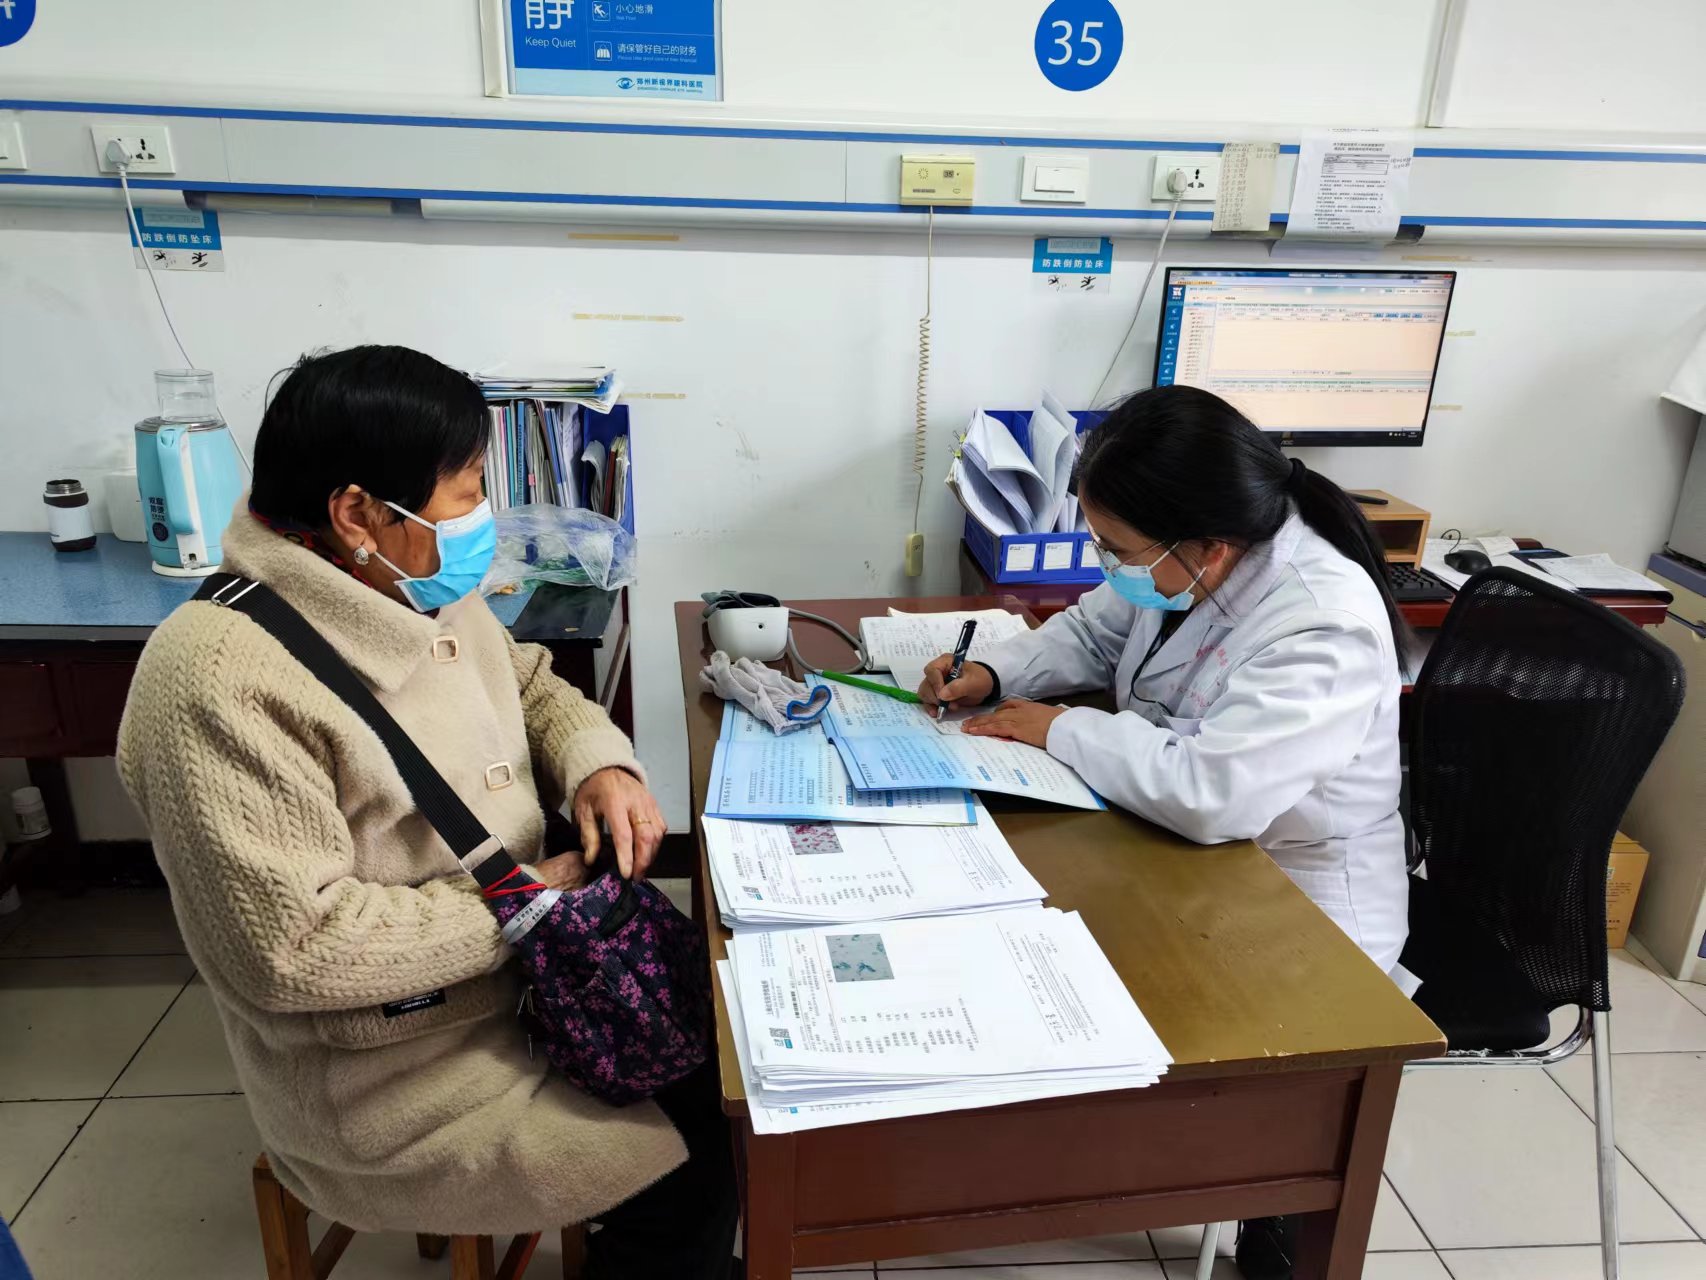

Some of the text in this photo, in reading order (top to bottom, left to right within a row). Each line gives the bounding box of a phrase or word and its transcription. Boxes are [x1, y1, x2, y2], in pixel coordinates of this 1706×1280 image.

[615, 3, 653, 14] 小心地滑
[525, 36, 576, 48] Keep Quiet
[1047, 19, 1104, 66] 35
[617, 42, 697, 56] 请保管好自己的财务
[1042, 258, 1104, 269] 防跌倒防坠床
